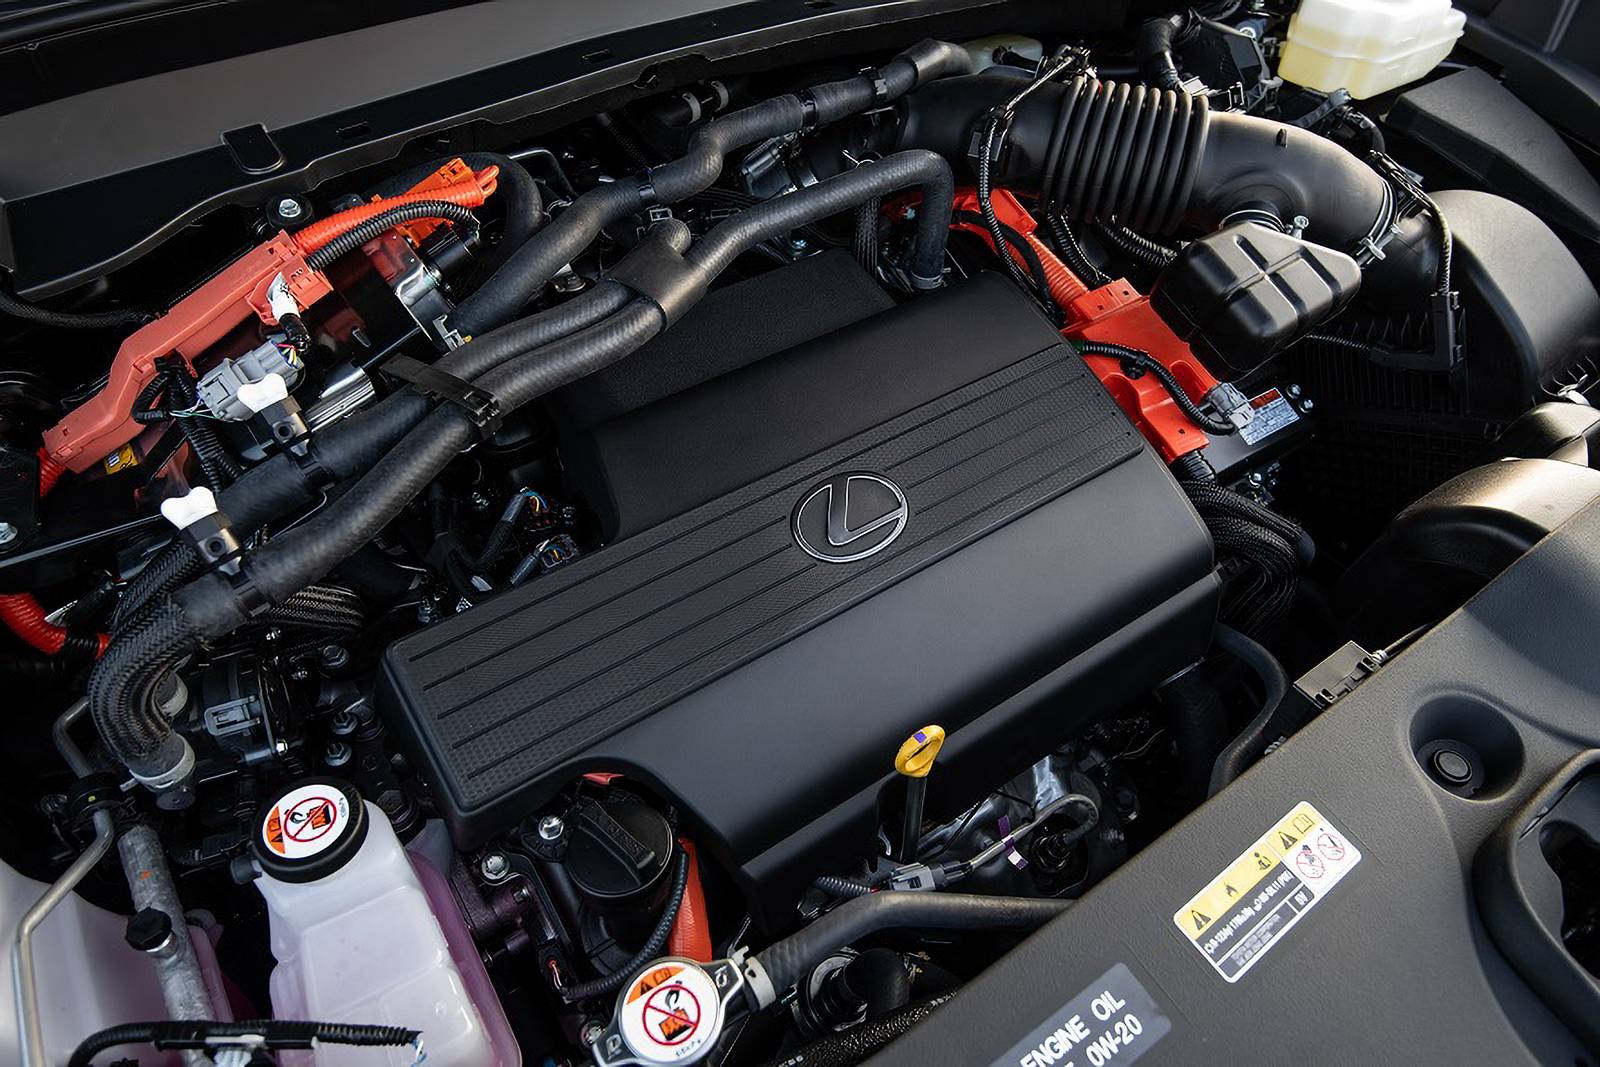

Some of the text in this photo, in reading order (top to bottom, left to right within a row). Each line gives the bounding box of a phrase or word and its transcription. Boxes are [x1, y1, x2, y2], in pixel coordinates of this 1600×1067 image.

[1020, 990, 1126, 1067] ENGINE OIL
[1086, 1013, 1143, 1067] 0W-20
